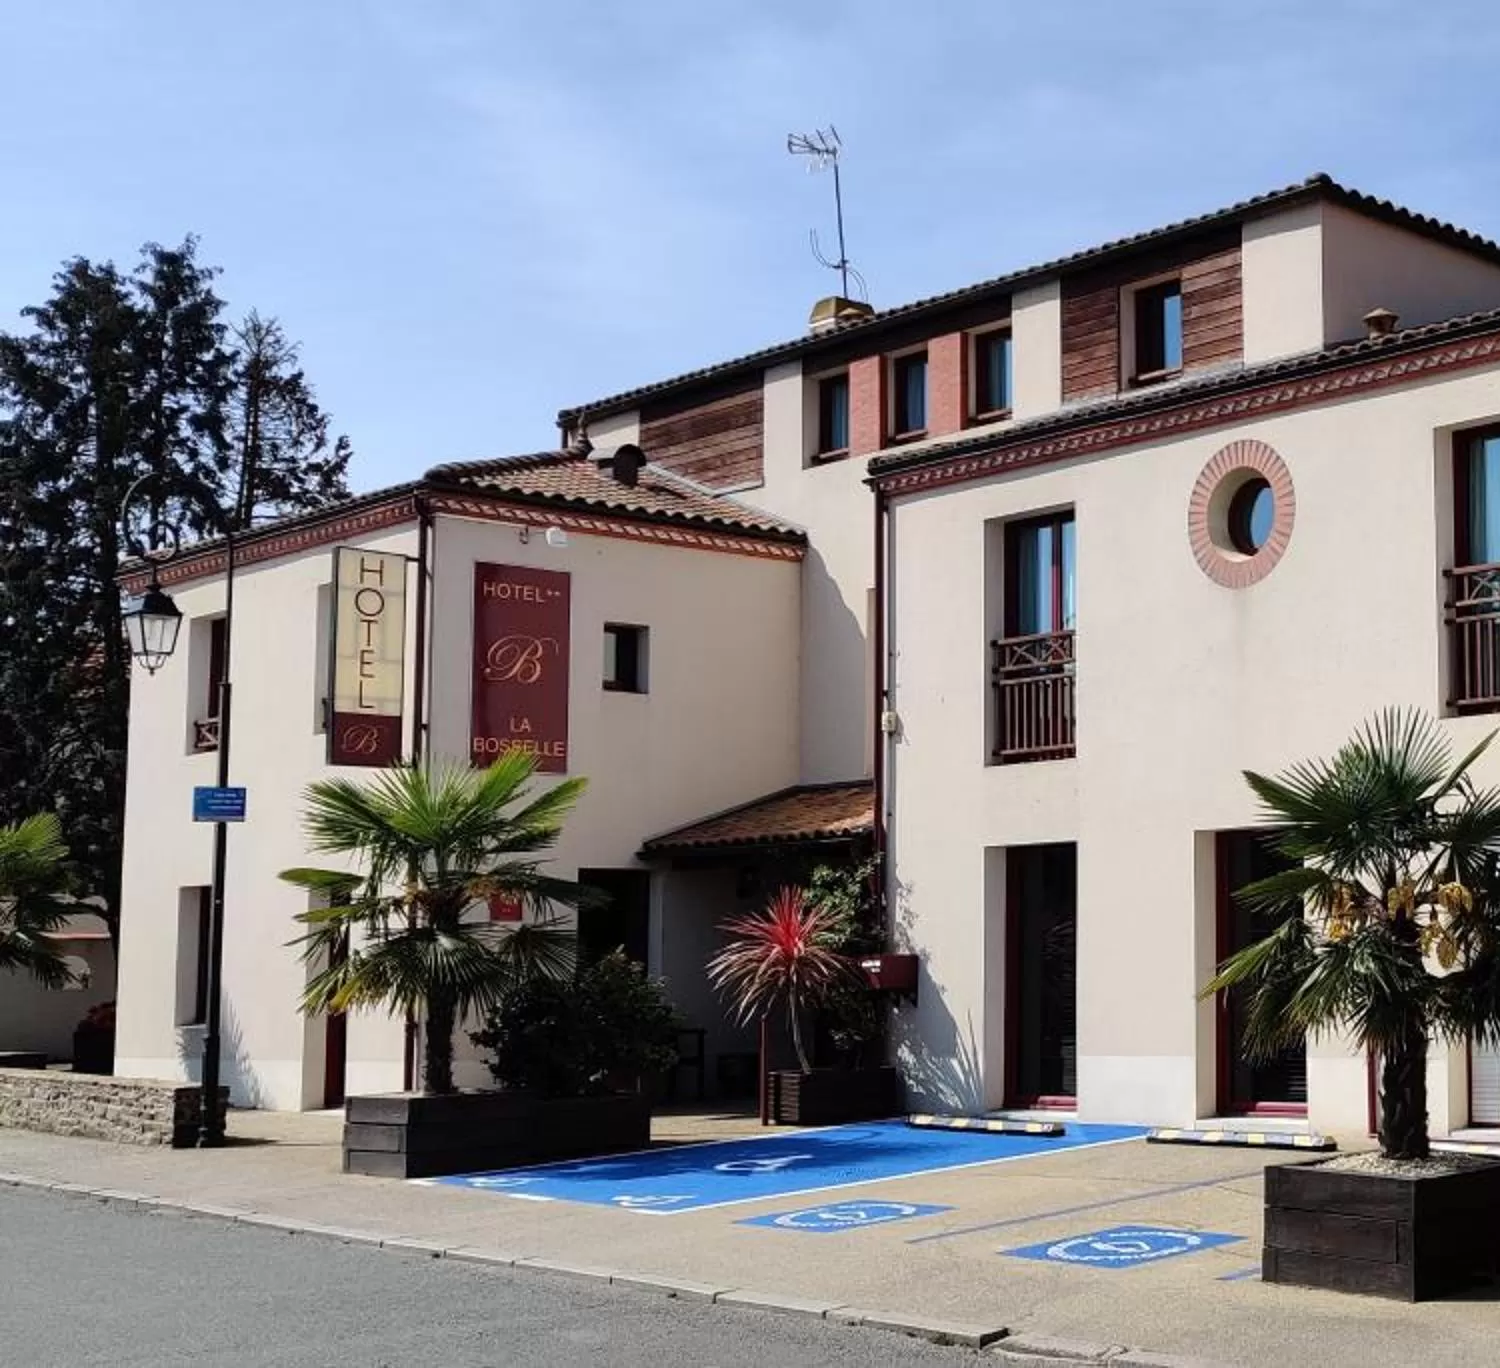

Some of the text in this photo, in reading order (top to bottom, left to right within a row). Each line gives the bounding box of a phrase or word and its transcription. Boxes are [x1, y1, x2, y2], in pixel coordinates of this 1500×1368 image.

[354, 557, 385, 709] HOTEL
[484, 634, 559, 684] B
[510, 717, 532, 733] LA
[473, 737, 566, 758] BOSSELLE
